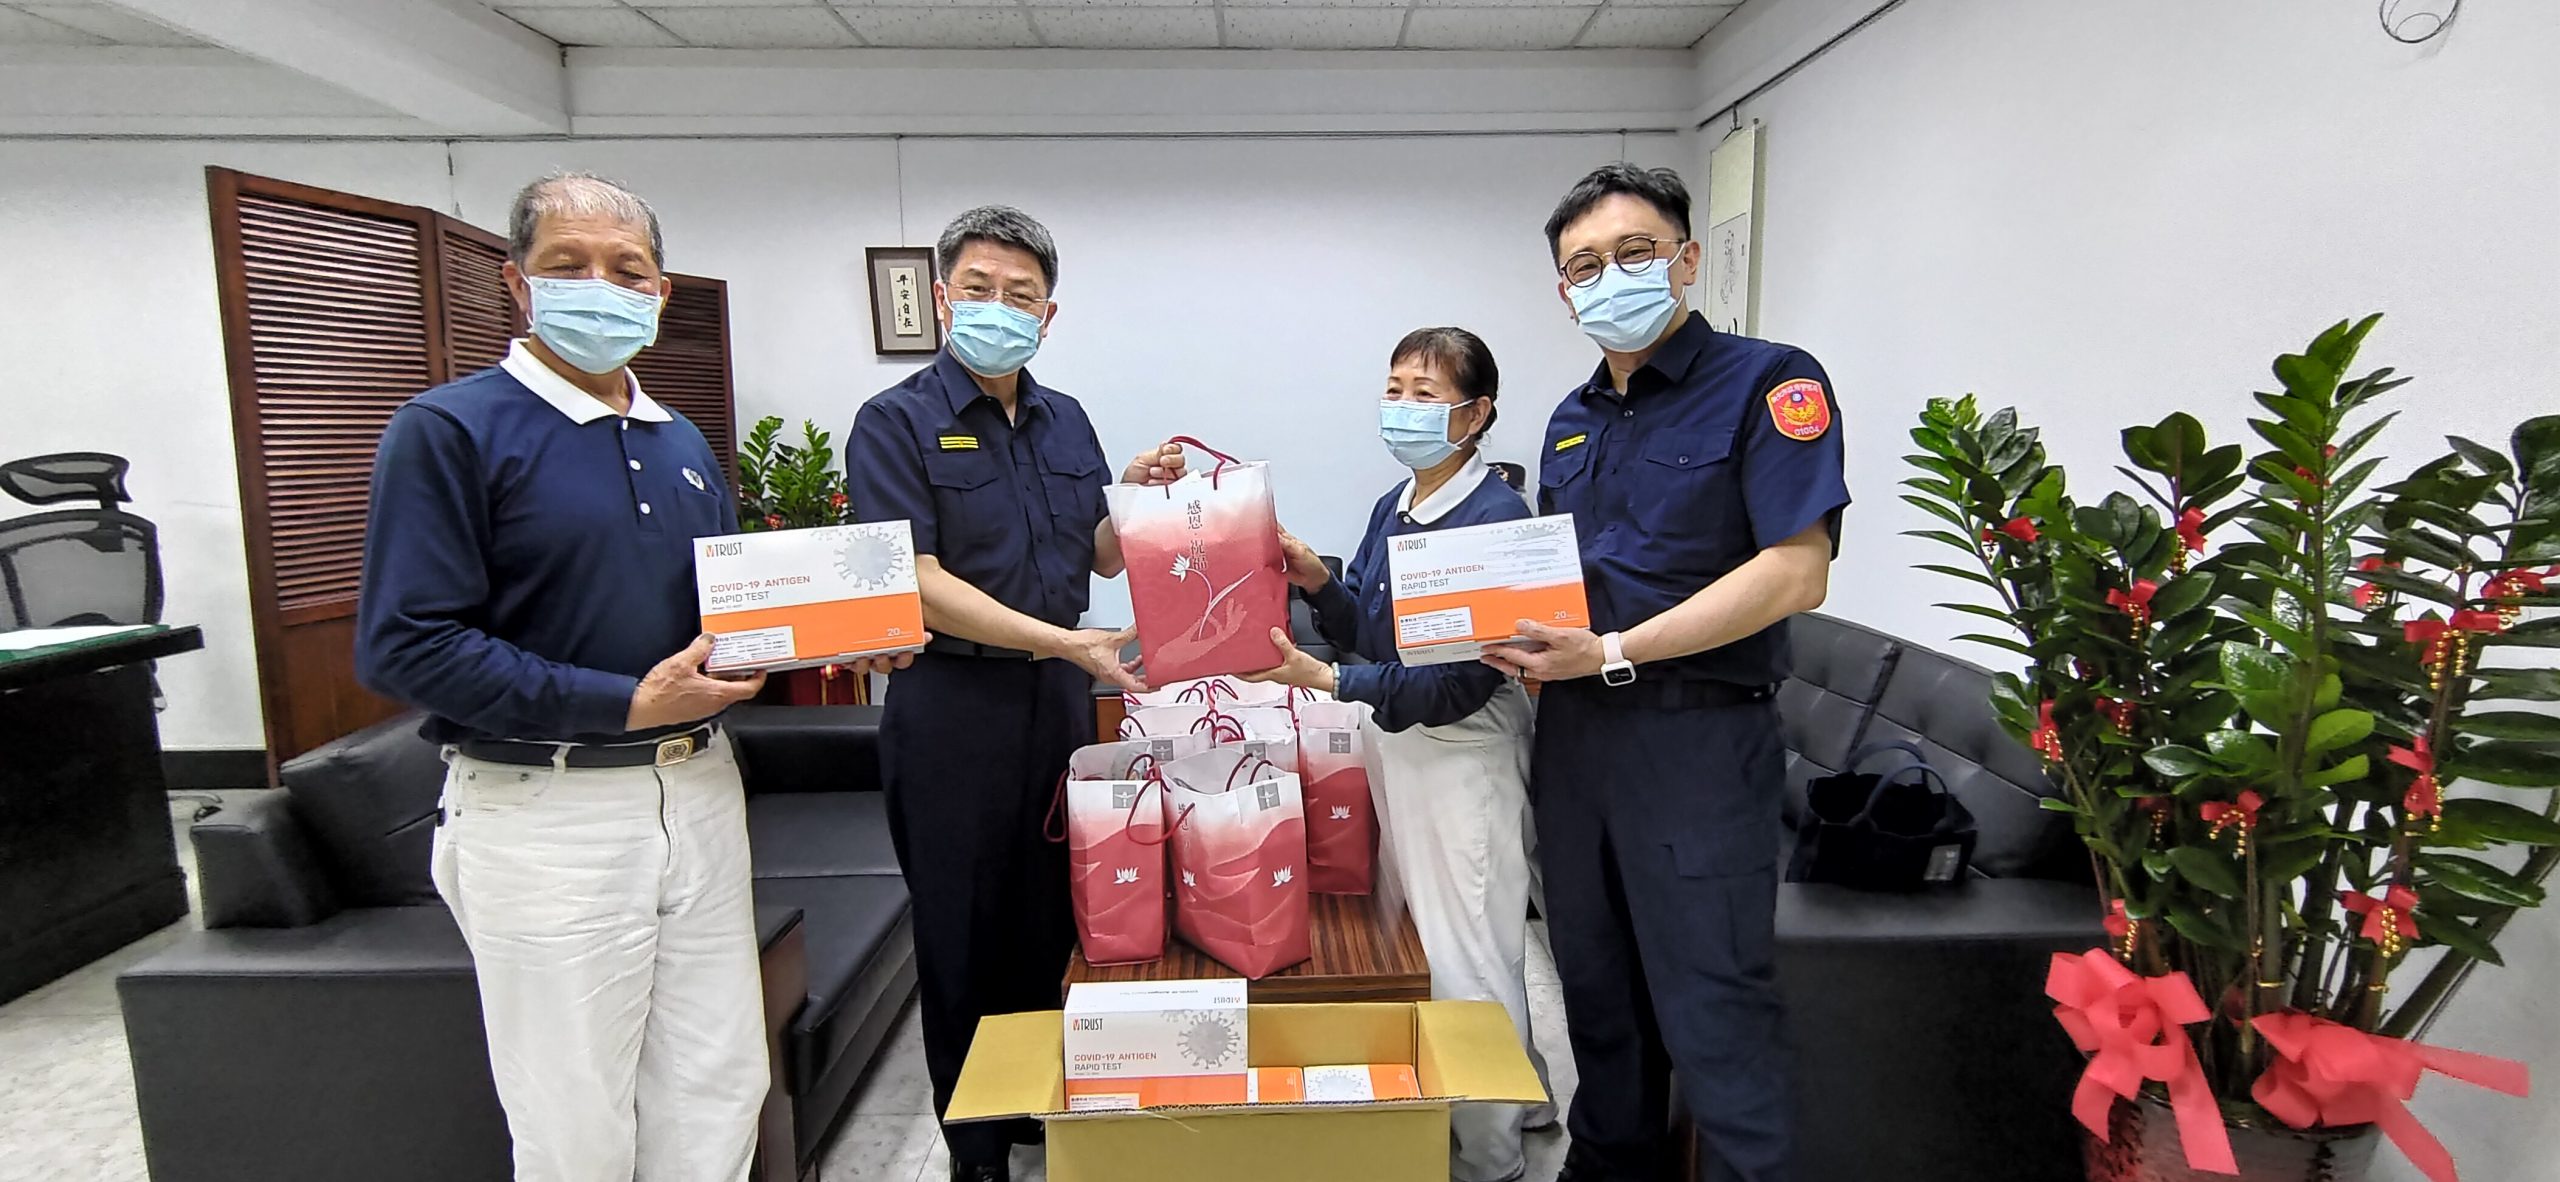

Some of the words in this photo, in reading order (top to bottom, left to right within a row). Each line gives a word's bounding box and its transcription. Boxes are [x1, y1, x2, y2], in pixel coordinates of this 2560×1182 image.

[1400, 569, 1442, 581] COVID-19
[1445, 564, 1485, 576] ANTIGEN
[710, 580, 760, 593] COVID-19
[764, 575, 811, 588] ANTIGEN
[1401, 581, 1427, 591] RAPID
[1429, 578, 1450, 588] TEST
[711, 594, 743, 605] RAPID
[745, 591, 770, 601] TEST
[1553, 610, 1567, 620] 20
[887, 627, 900, 637] 20
[1074, 1053, 1115, 1062] COVID-19
[1118, 1052, 1157, 1060] ANTIGEN
[1074, 1063, 1100, 1071] RAPID
[1102, 1062, 1122, 1071] TEST
